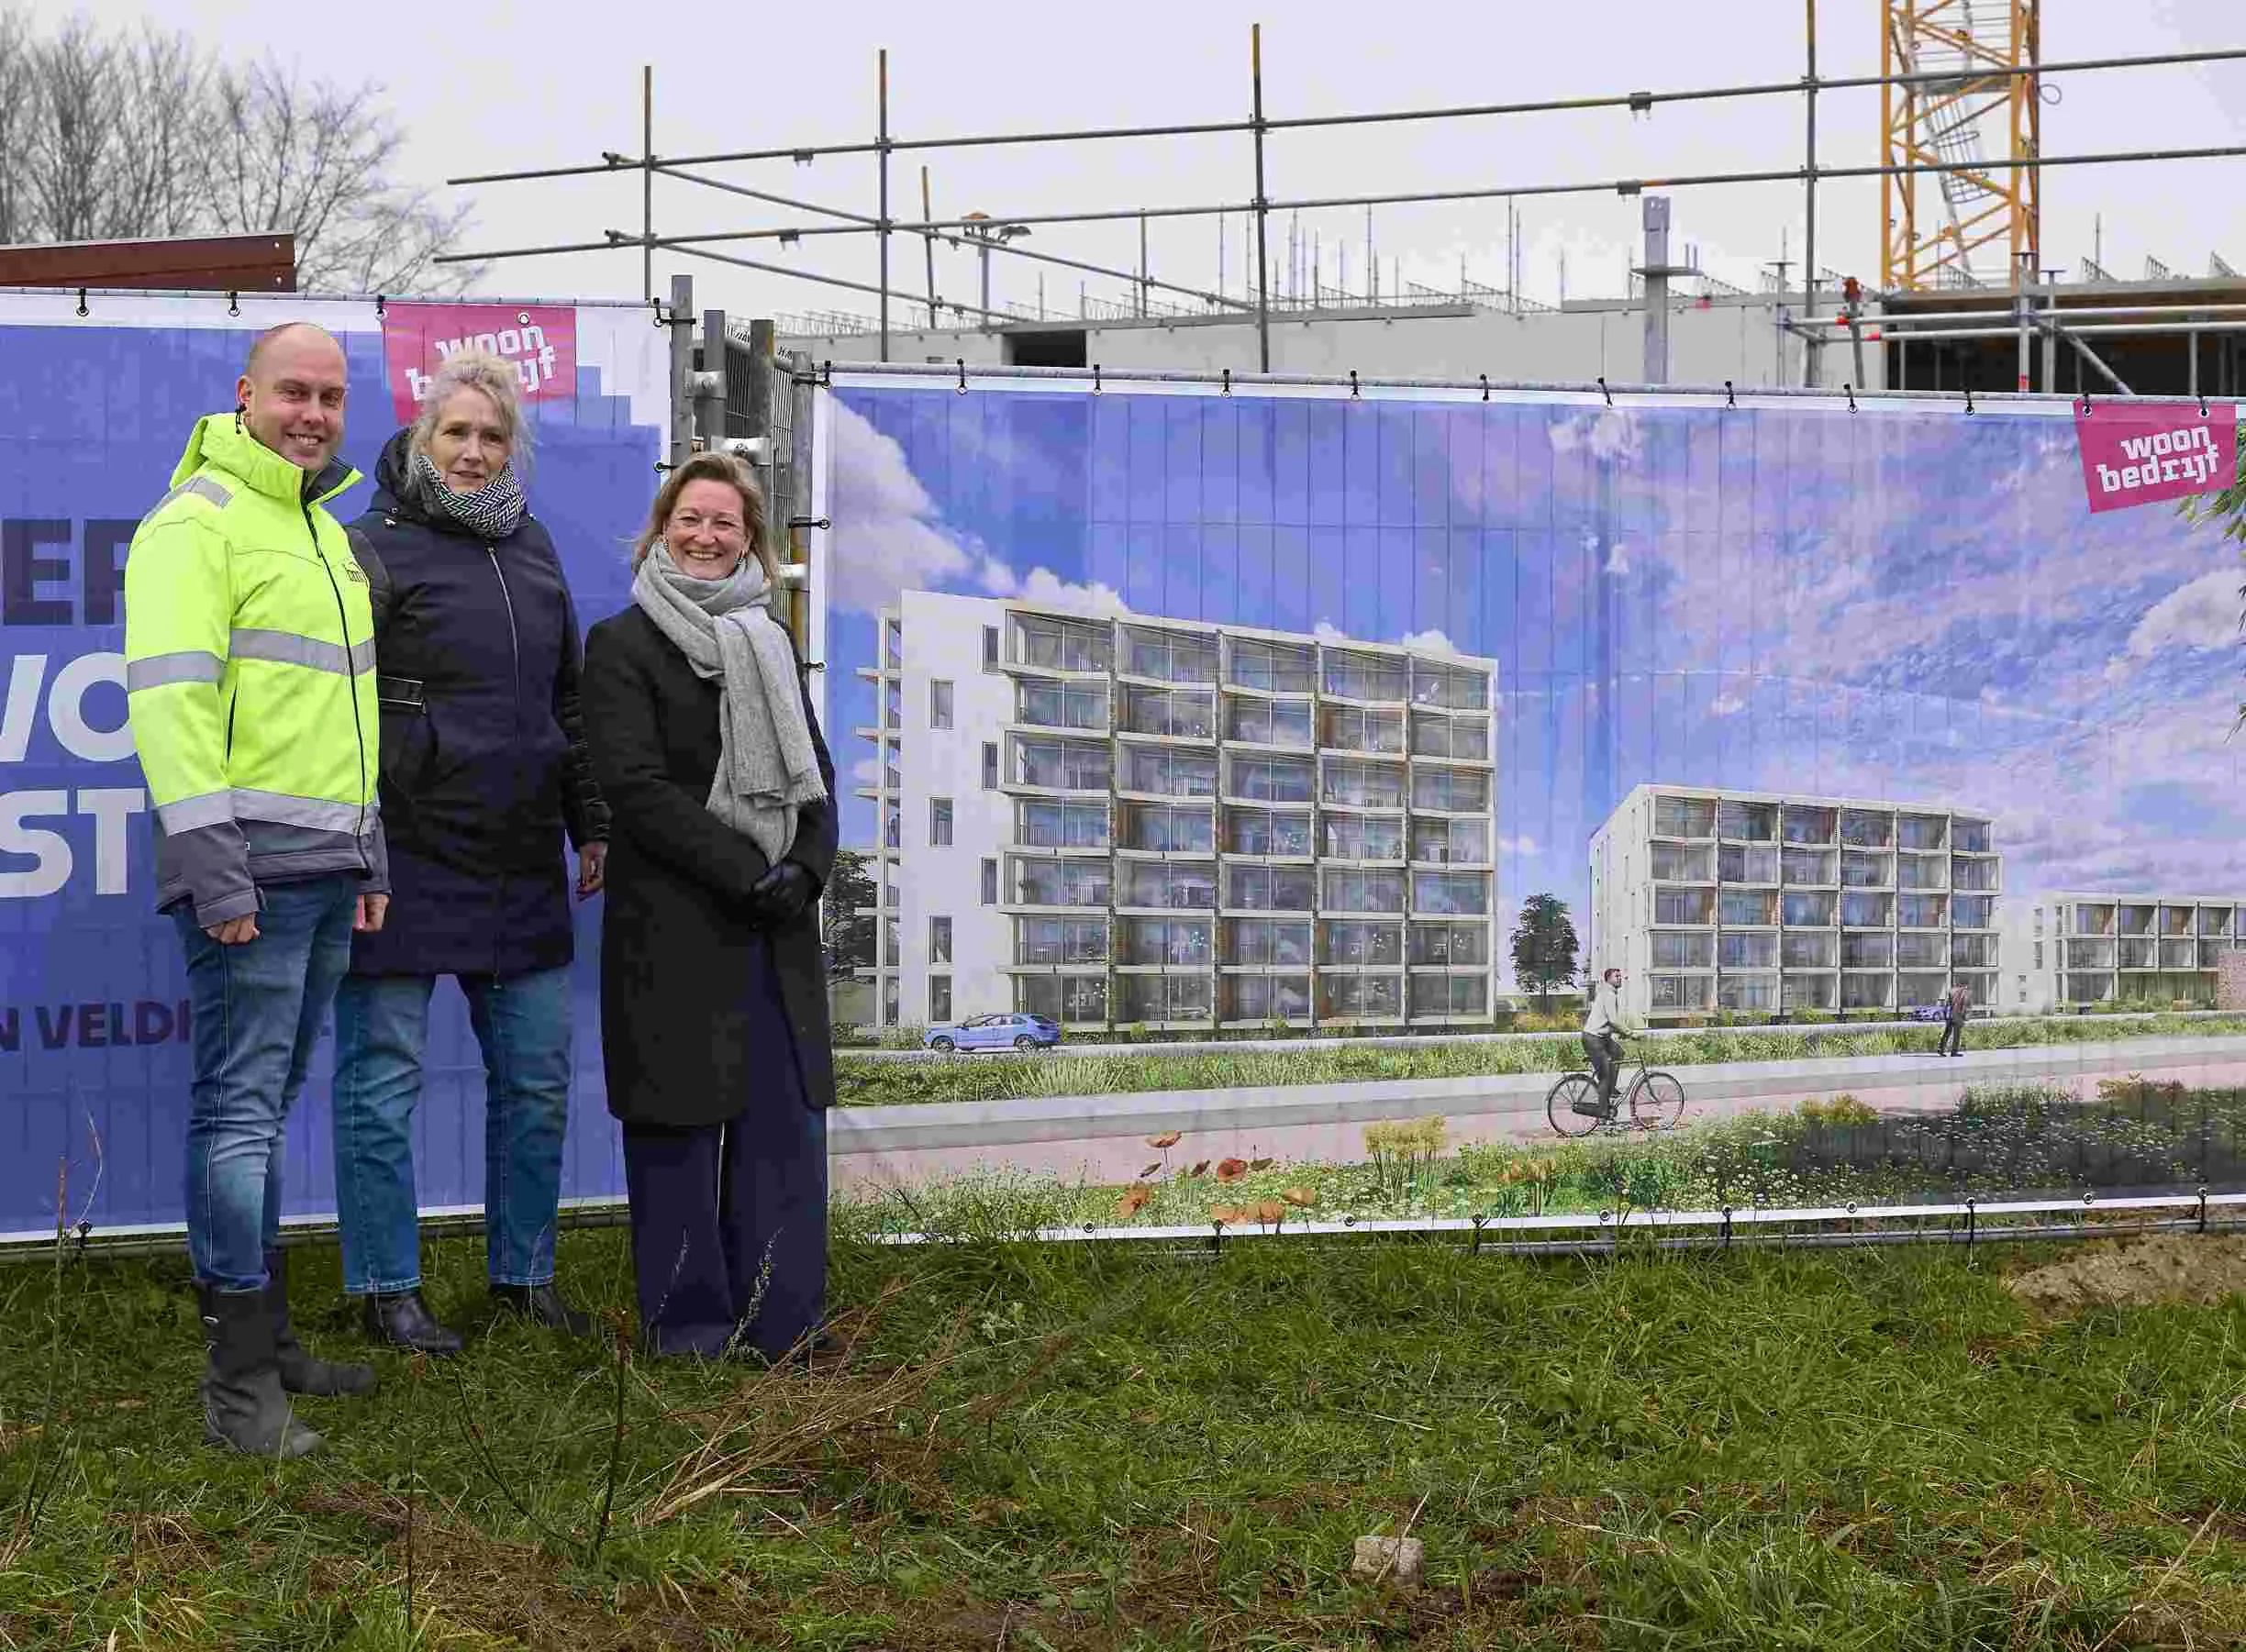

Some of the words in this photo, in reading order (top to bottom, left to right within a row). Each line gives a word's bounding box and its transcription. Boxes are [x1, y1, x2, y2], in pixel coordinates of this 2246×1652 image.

[435, 326, 545, 358] woon
[2121, 426, 2211, 460] woon
[2096, 444, 2219, 493] bedrijf
